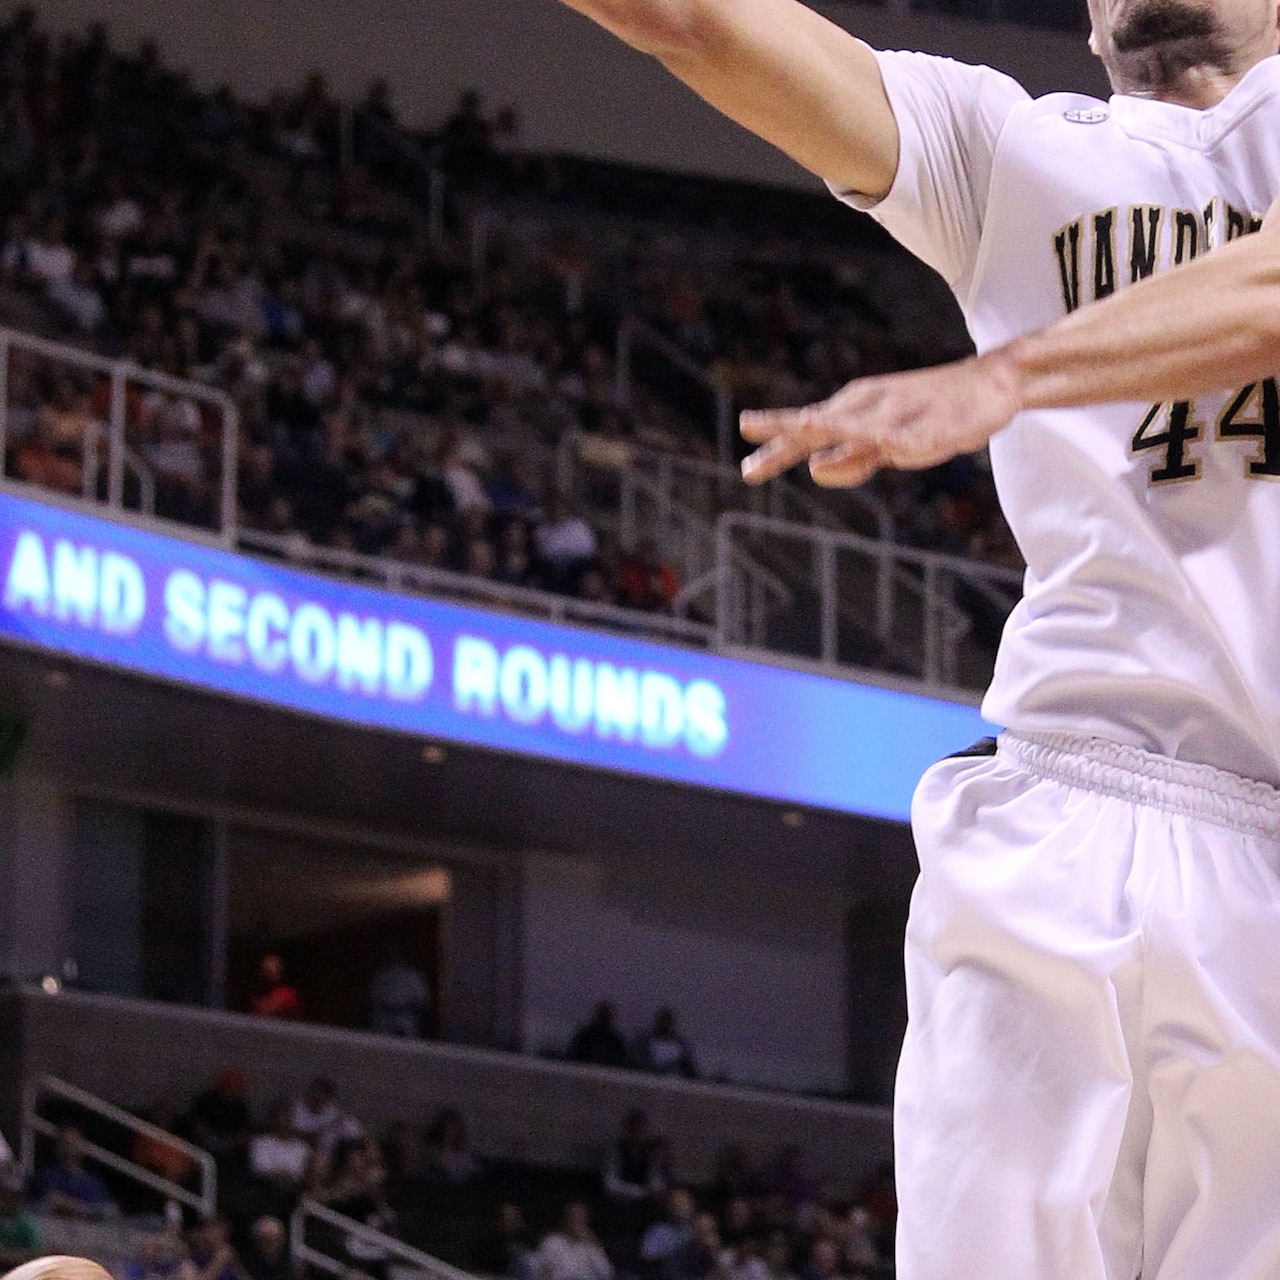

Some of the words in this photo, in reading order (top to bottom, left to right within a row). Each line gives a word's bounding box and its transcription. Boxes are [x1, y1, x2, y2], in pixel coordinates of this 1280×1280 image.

[5, 531, 147, 634] AND
[164, 570, 434, 702] SECOND
[452, 635, 730, 760] ROUNDS
